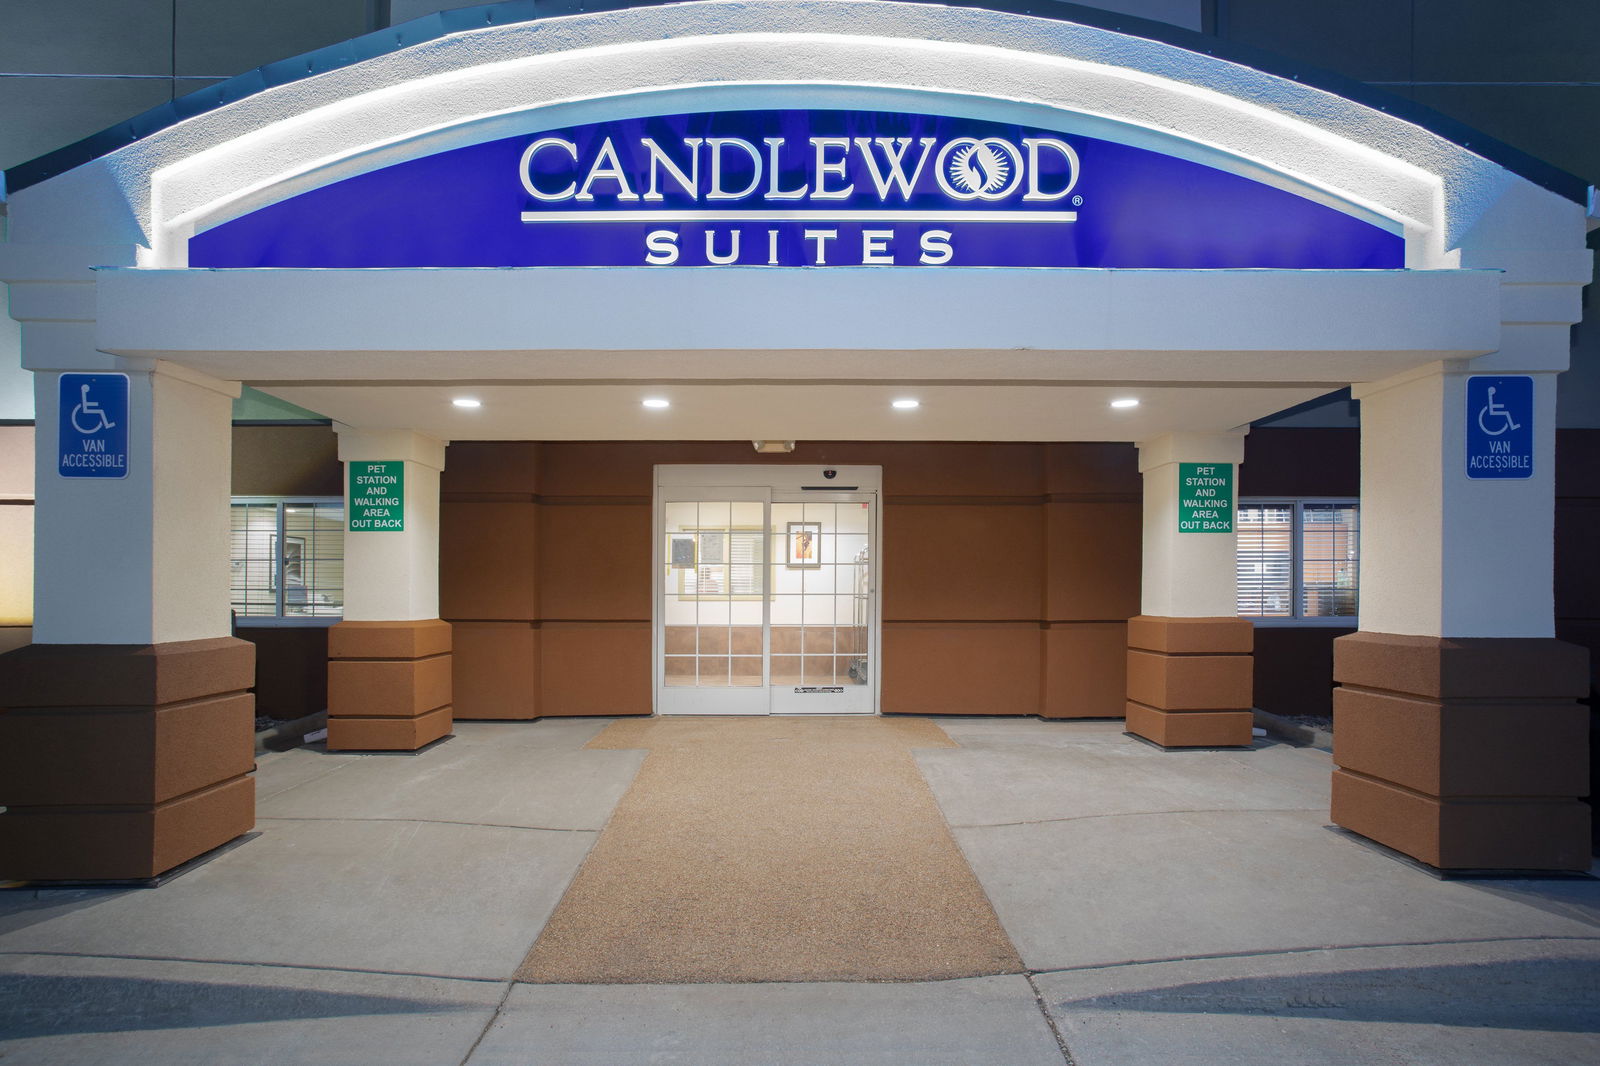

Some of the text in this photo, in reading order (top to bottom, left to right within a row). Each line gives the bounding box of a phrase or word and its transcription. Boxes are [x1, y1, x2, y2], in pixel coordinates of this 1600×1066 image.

[519, 136, 1081, 202] CANDLEWOOD
[645, 229, 954, 265] SUITES
[82, 439, 105, 452] VAN
[1489, 440, 1511, 454] VAN
[62, 453, 125, 468] ACCESSIBLE
[1470, 455, 1530, 469] ACCESSIBLE
[367, 464, 387, 473] PET
[1196, 466, 1216, 475] PET
[356, 475, 397, 484] STATION
[1185, 477, 1226, 486] STATION
[366, 486, 388, 495] AND
[1195, 488, 1216, 497] AND
[354, 497, 400, 506] WALKING
[1183, 499, 1228, 508] WALKING
[362, 508, 391, 517] AREA
[1191, 510, 1219, 519] AREA
[351, 519, 402, 528] OUT BACK
[1180, 520, 1230, 529] OUT BACK
